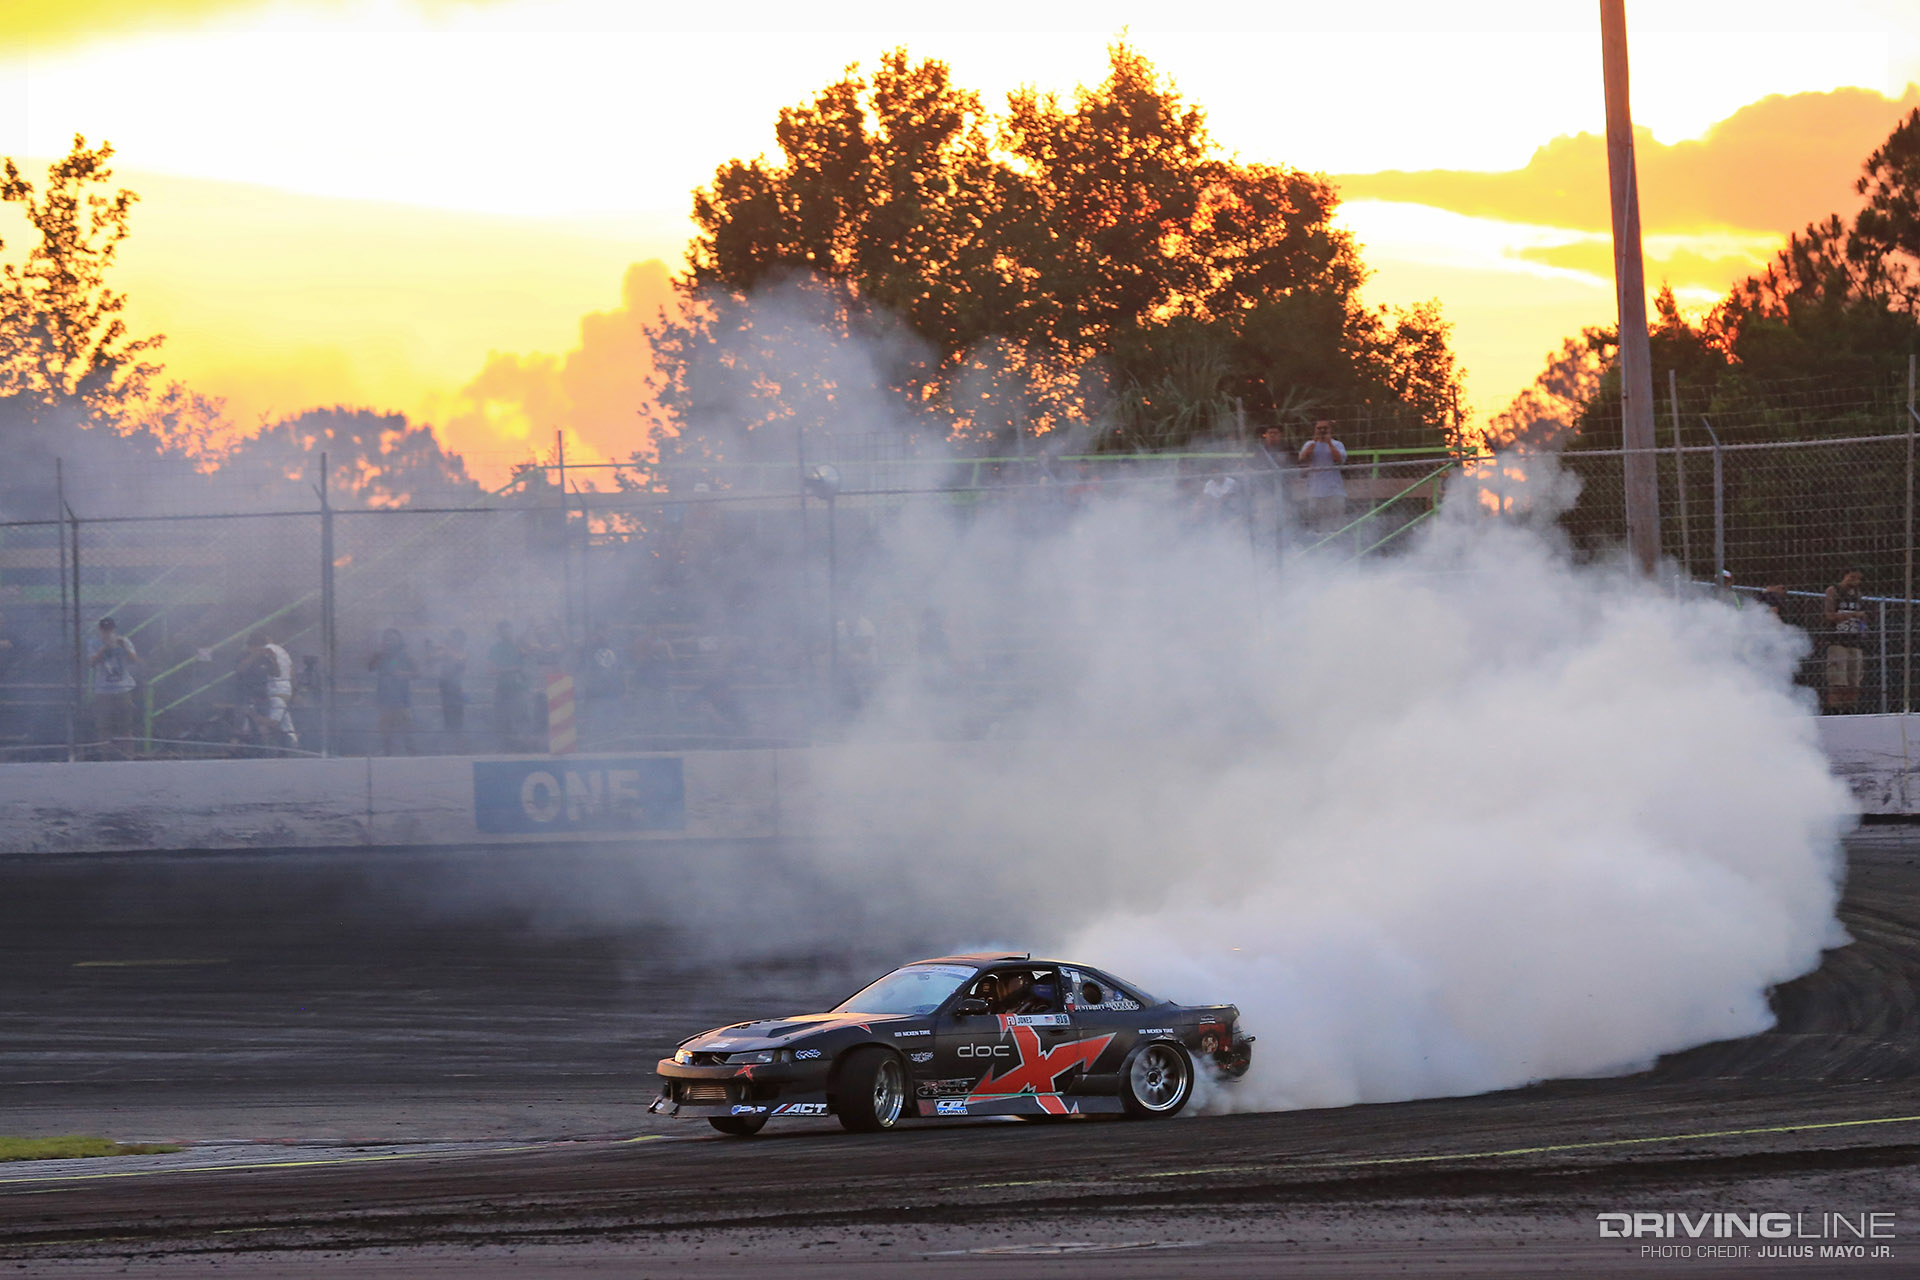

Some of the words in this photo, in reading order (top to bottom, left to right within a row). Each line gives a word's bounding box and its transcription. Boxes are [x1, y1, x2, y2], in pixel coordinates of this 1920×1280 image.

[521, 770, 643, 822] ONE
[1017, 1016, 1033, 1025] JONES
[957, 1042, 1010, 1058] doc
